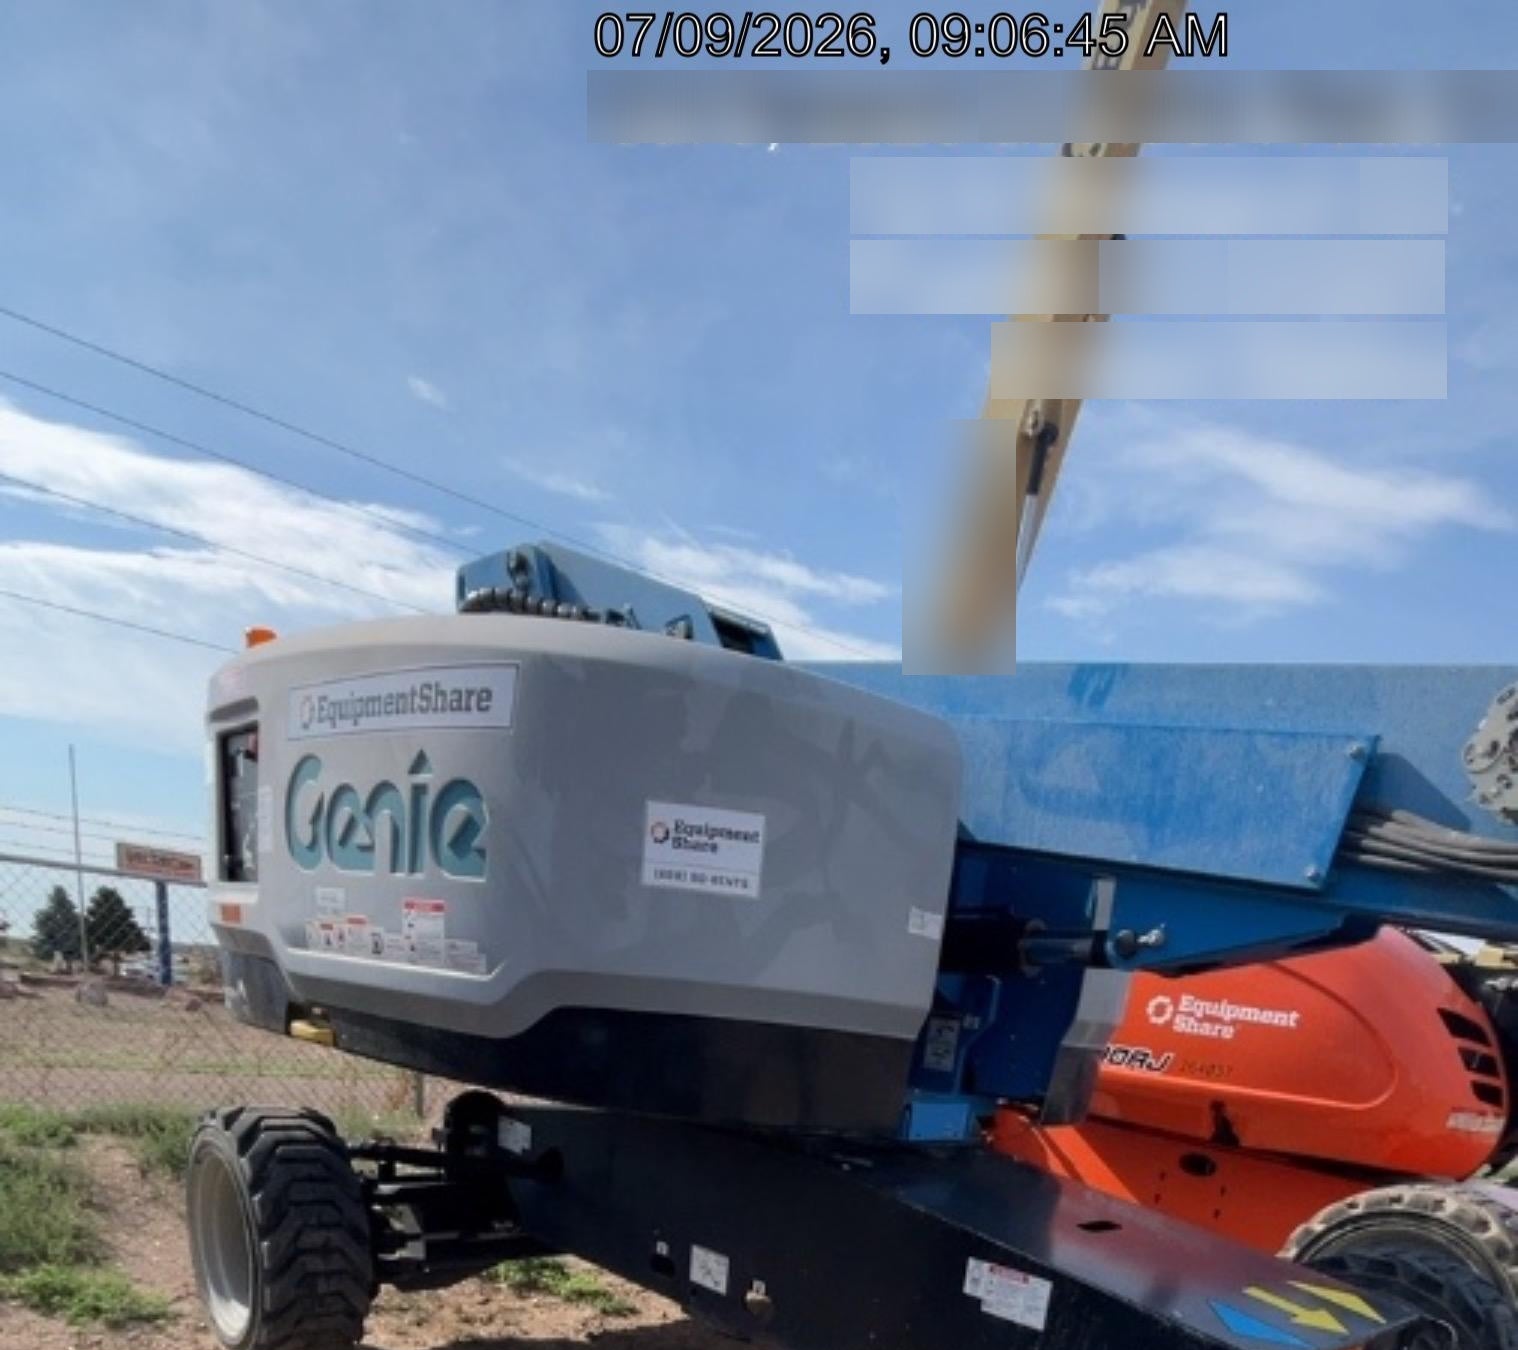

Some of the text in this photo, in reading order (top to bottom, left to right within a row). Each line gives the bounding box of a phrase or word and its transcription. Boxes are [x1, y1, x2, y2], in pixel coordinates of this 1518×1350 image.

[317, 681, 493, 729] EquipmentShare
[285, 749, 487, 881] Genie
[672, 836, 718, 854] Share
[674, 819, 760, 844] Equipment
[1177, 995, 1300, 1027] Equipment
[1172, 1013, 1235, 1039] Share
